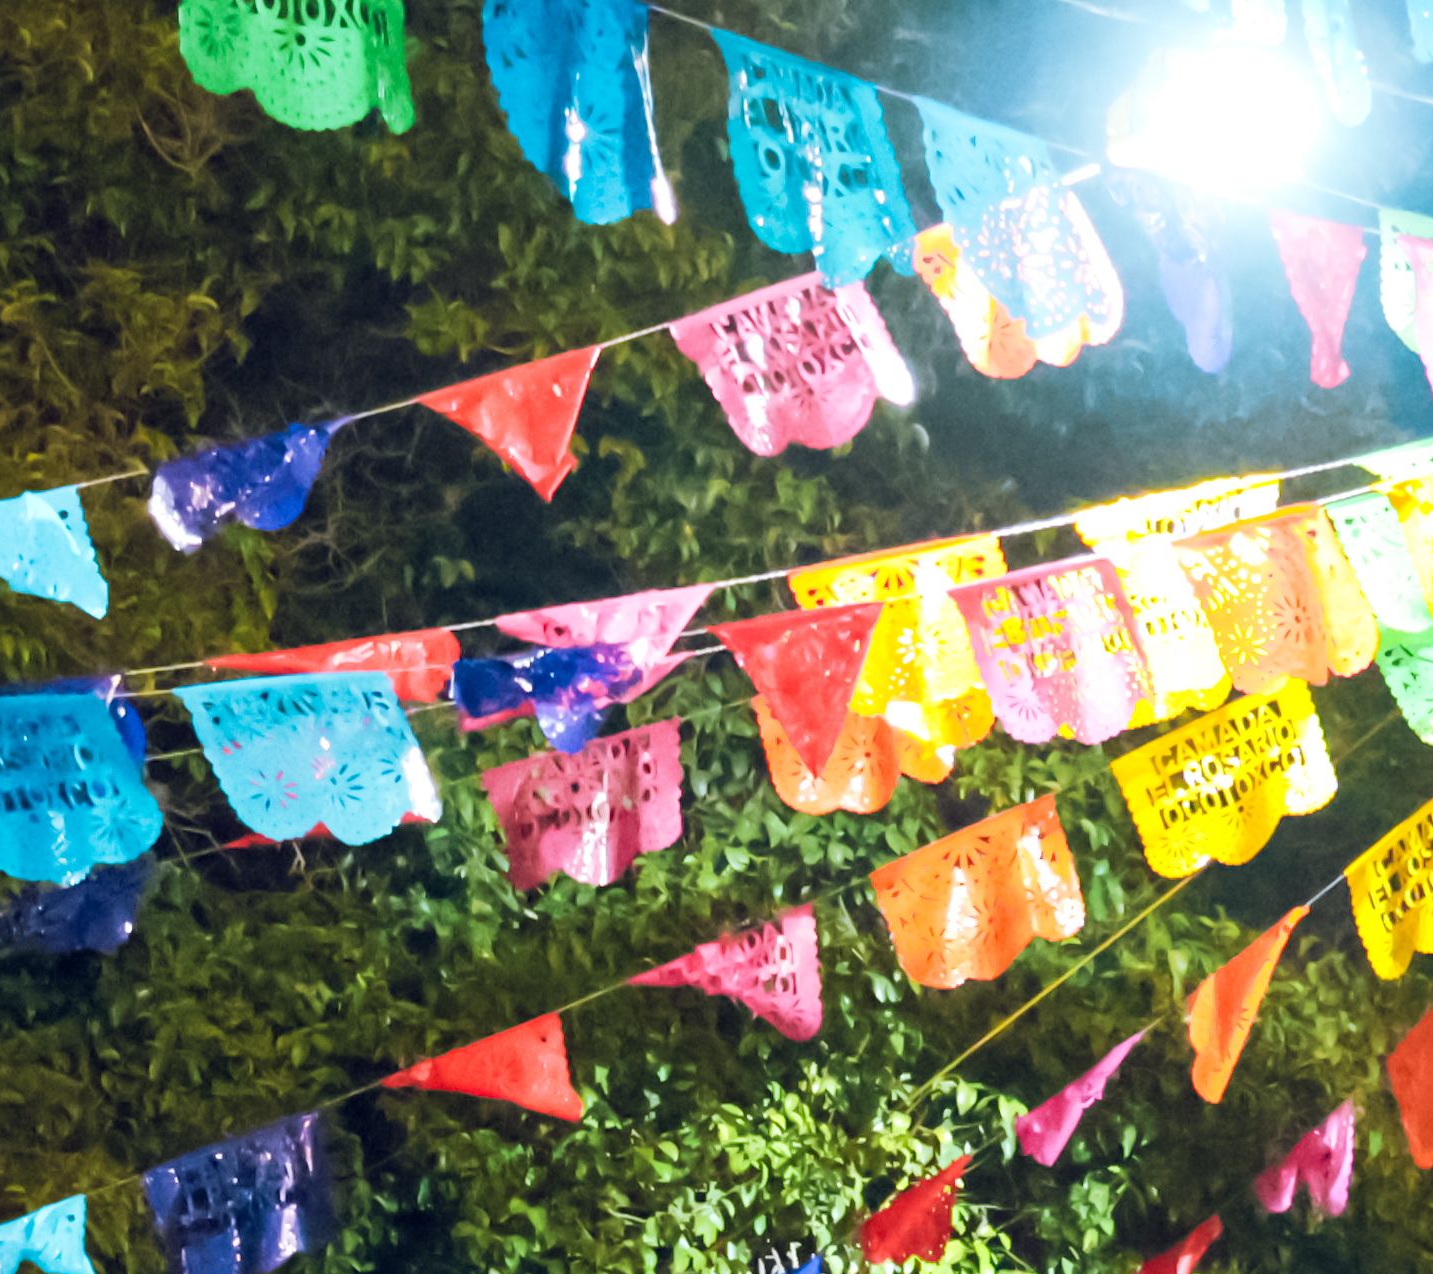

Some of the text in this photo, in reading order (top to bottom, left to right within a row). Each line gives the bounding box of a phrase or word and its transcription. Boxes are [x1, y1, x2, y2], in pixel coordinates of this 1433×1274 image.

[1146, 719, 1297, 806] EL ROSARIO
[1151, 700, 1283, 774] CAMADA
[1160, 745, 1306, 830] OCOTOXCO
